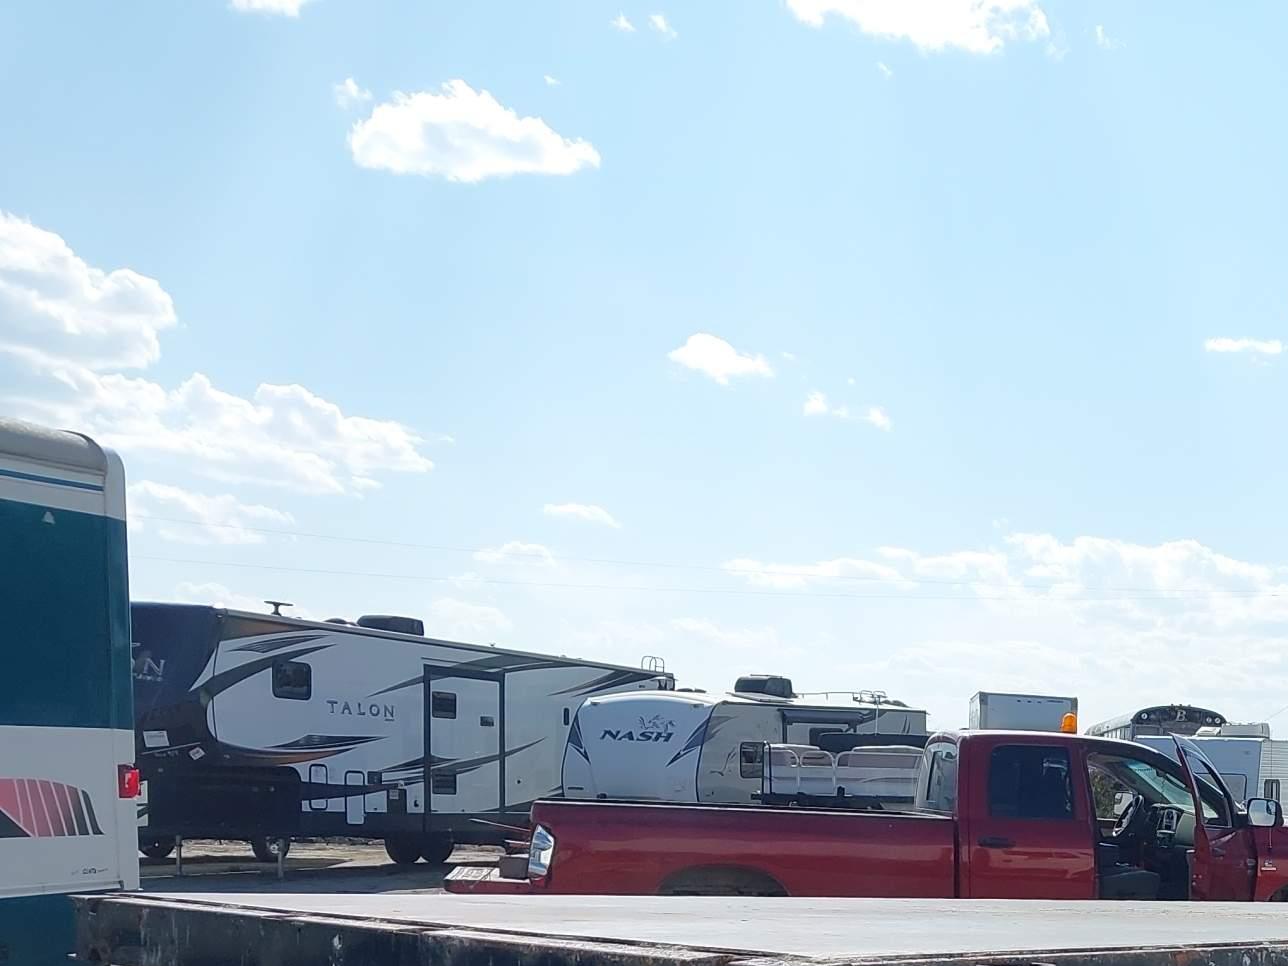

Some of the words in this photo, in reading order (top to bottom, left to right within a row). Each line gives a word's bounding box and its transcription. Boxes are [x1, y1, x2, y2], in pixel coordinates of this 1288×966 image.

[326, 700, 395, 719] TALON
[1175, 709, 1188, 722] B
[600, 729, 675, 743] NASH
